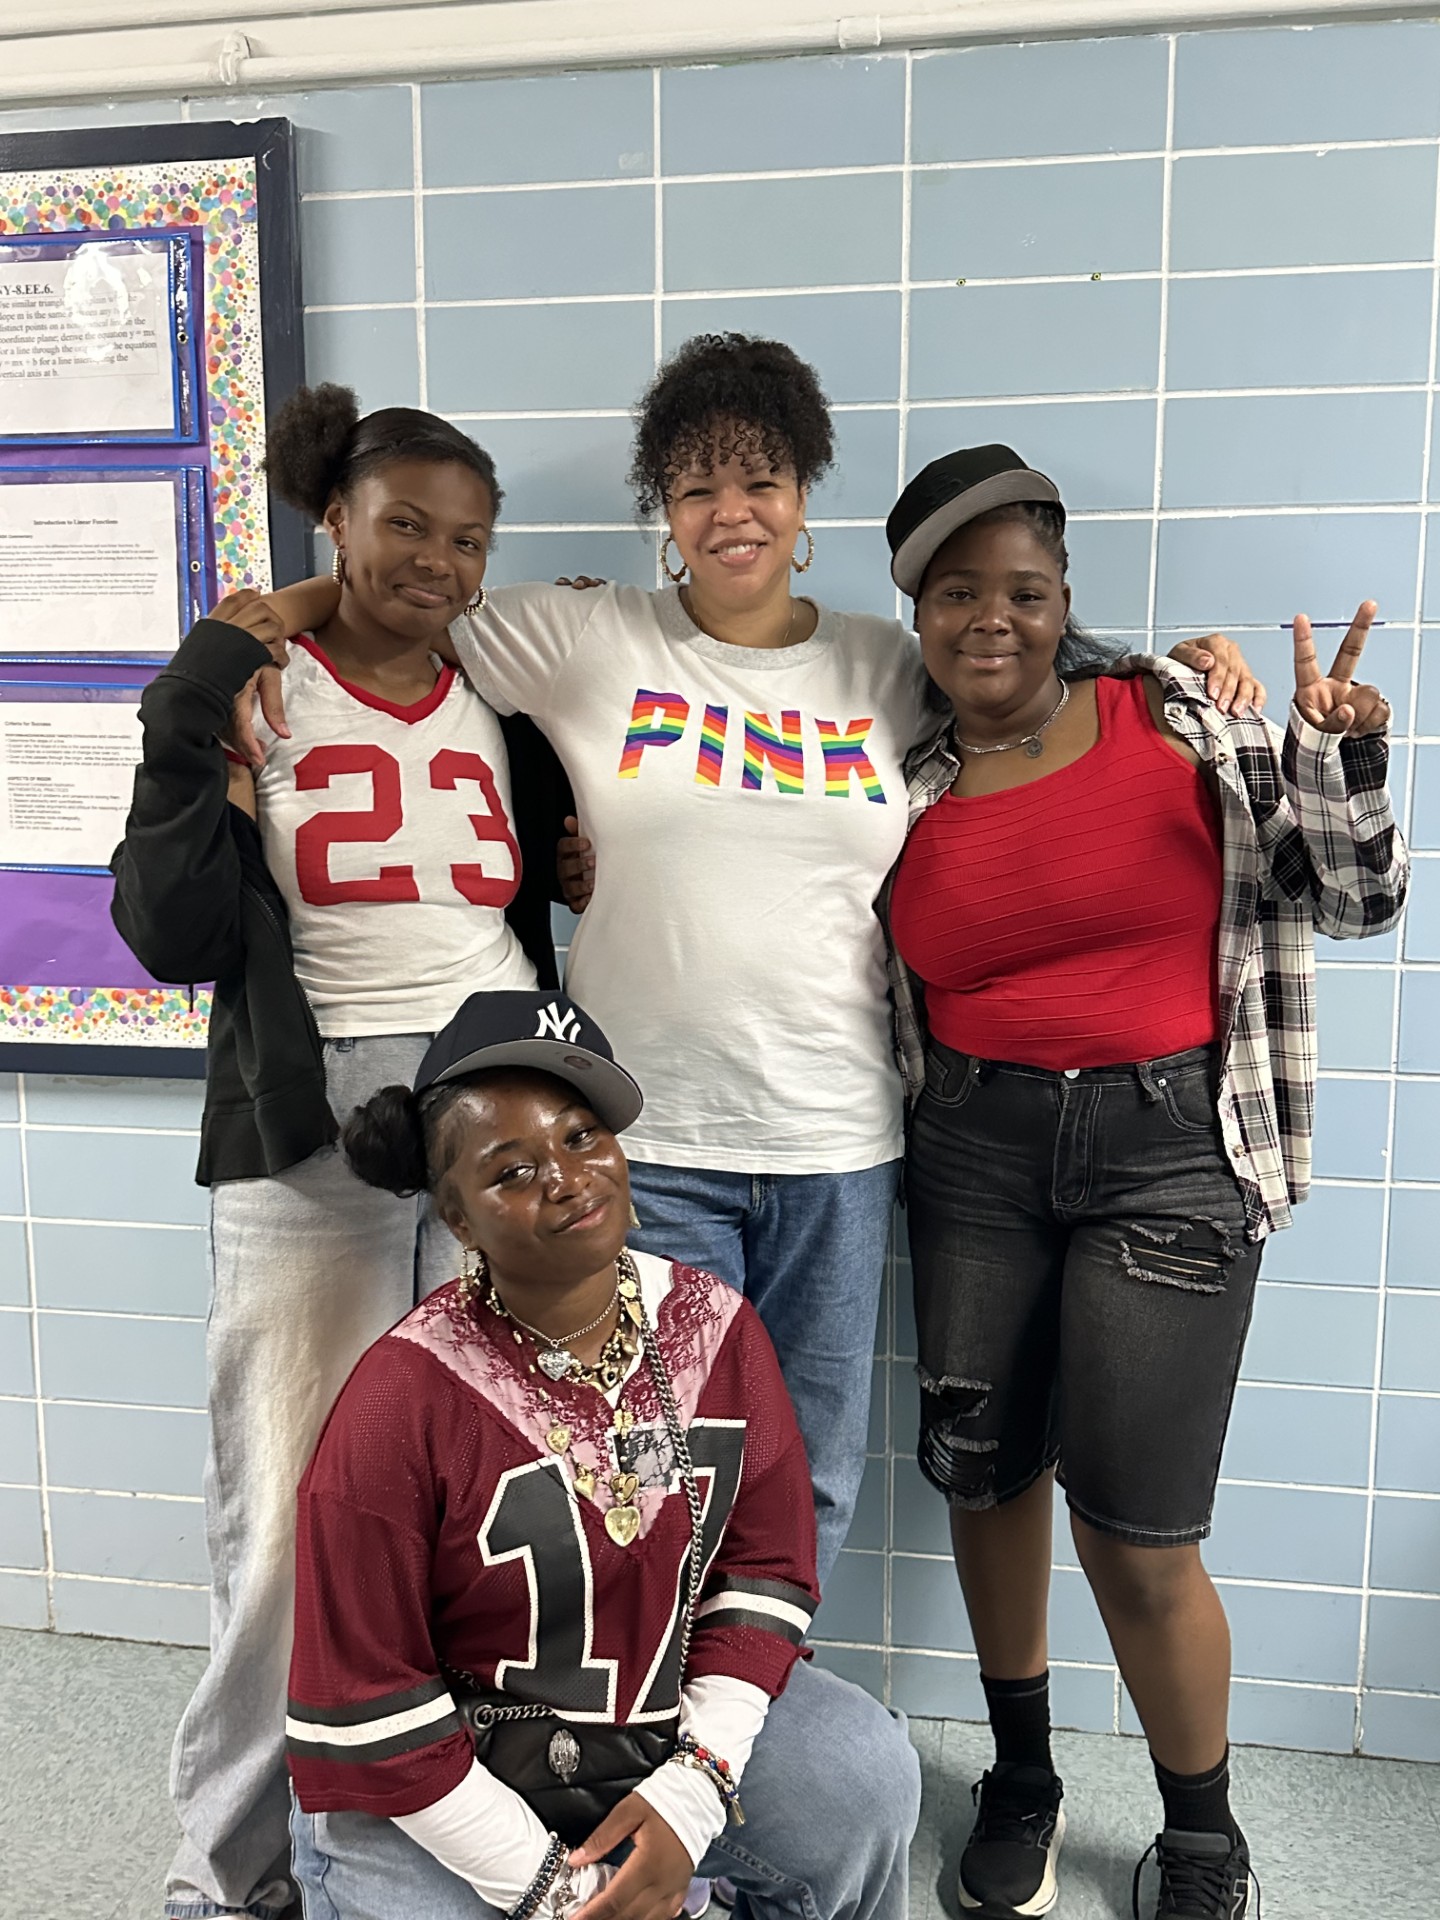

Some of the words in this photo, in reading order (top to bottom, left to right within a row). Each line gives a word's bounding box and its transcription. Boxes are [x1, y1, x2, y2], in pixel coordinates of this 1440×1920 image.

[11, 300, 37, 308] similar
[39, 298, 65, 308] triangl
[0, 312, 15, 322] lope
[34, 310, 46, 319] the
[25, 324, 47, 333] points
[134, 317, 146, 325] the
[61, 333, 83, 341] derive
[97, 331, 127, 340] equation
[129, 331, 135, 339] y
[32, 345, 60, 355] through
[124, 342, 157, 351] equation
[40, 357, 50, 365] for
[117, 353, 128, 361] the
[27, 369, 42, 377] axis
[617, 688, 888, 805] PINK
[293, 744, 523, 909] 23
[534, 1001, 582, 1044] NY
[477, 1416, 748, 1725] 17
